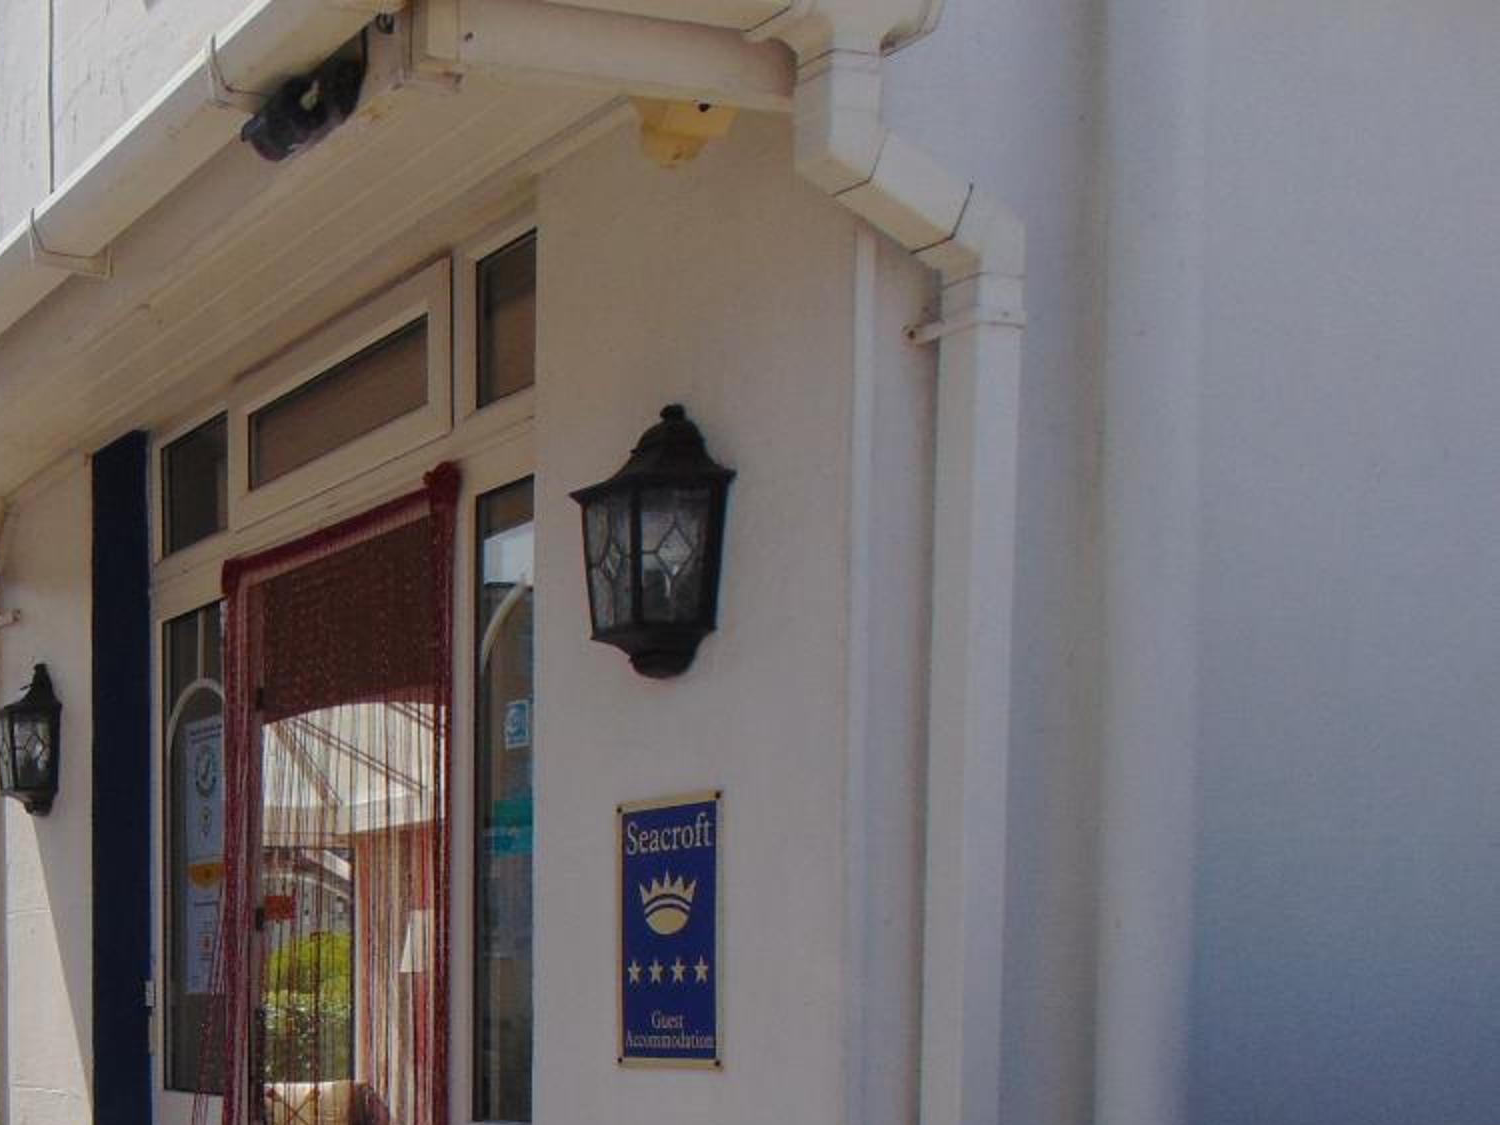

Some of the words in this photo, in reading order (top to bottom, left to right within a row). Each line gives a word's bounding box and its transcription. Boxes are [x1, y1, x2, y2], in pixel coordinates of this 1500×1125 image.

[627, 812, 714, 855] Seacroft
[651, 1009, 684, 1029] Guest
[626, 1029, 715, 1050] Accommodation
